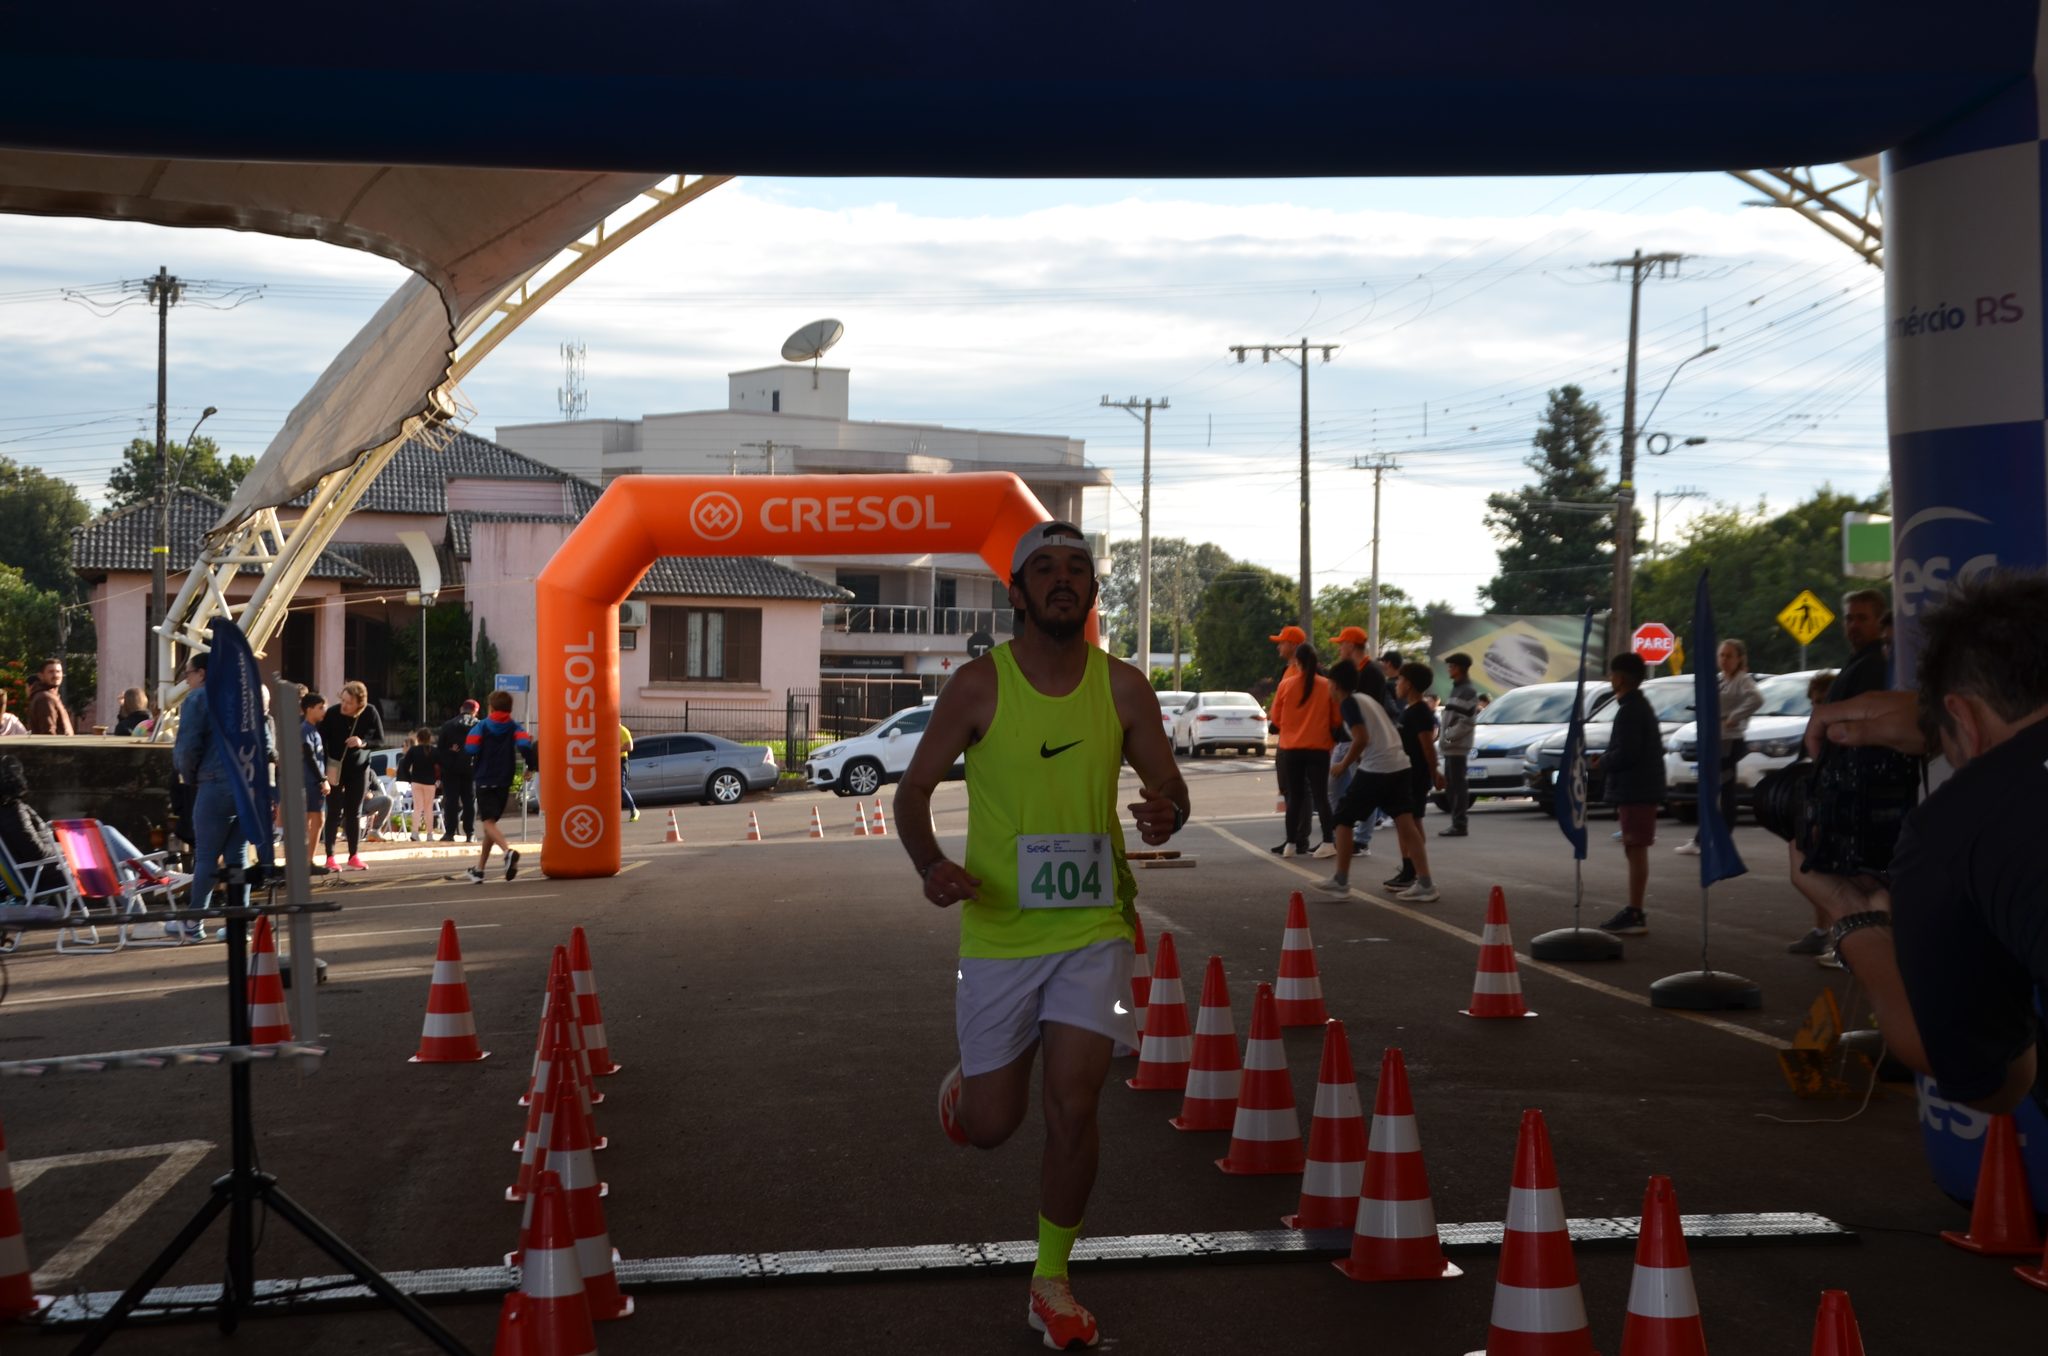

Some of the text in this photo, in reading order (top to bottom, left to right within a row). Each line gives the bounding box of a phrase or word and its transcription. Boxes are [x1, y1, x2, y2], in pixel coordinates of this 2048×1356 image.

[1975, 292, 2025, 327] RS
[759, 494, 952, 534] CRESOL
[1634, 636, 1672, 649] PARE
[564, 630, 597, 791] CRESOL
[1031, 861, 1102, 900] 404
